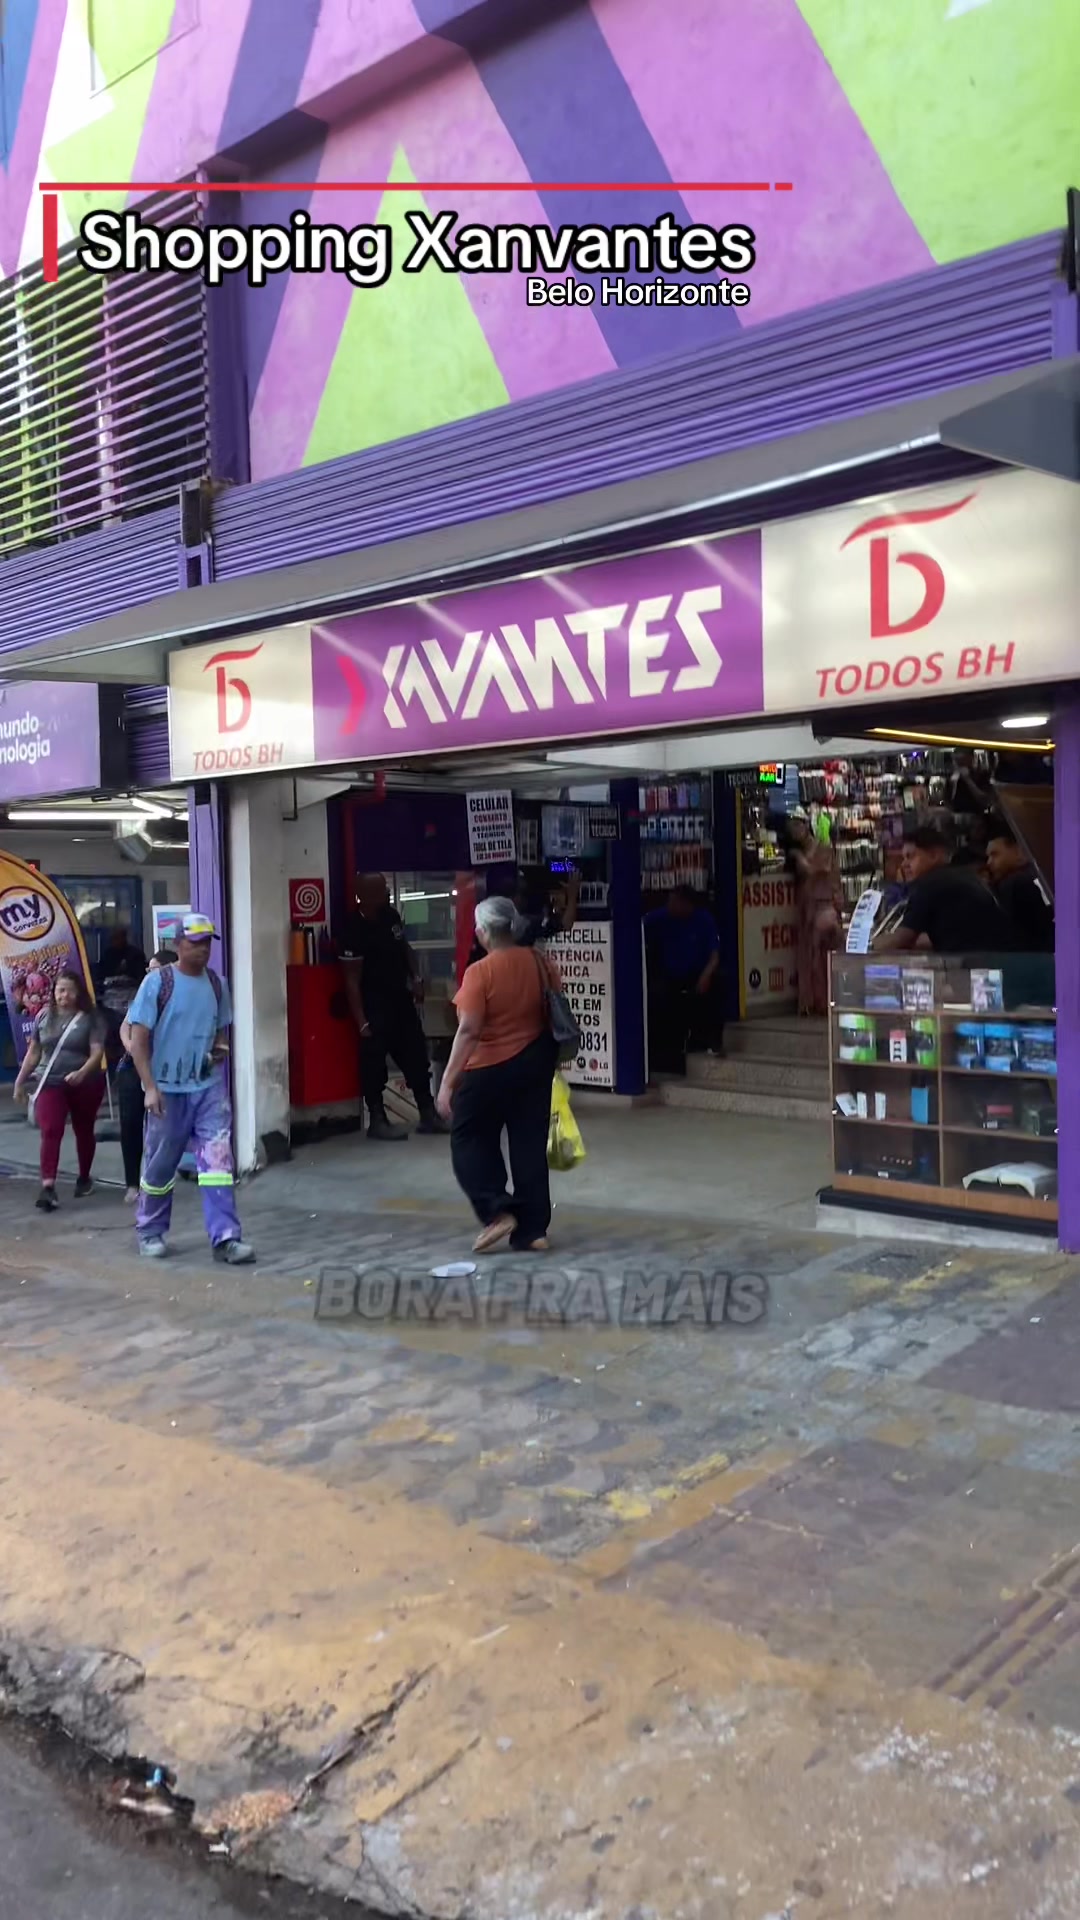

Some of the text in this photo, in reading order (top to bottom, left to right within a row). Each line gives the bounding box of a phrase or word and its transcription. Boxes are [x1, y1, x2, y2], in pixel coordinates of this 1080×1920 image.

[816, 642, 1015, 698] TODOS BH
[0, 734, 50, 765] nologia
[193, 742, 284, 772] TODOS BH
[742, 881, 799, 907] ASSIST
[0, 894, 41, 927] my
[546, 948, 604, 962] ISTÊNCIA
[560, 965, 590, 978] NICA
[589, 984, 606, 996] DE
[583, 998, 602, 1012] EM
[579, 1031, 607, 1052] 0831
